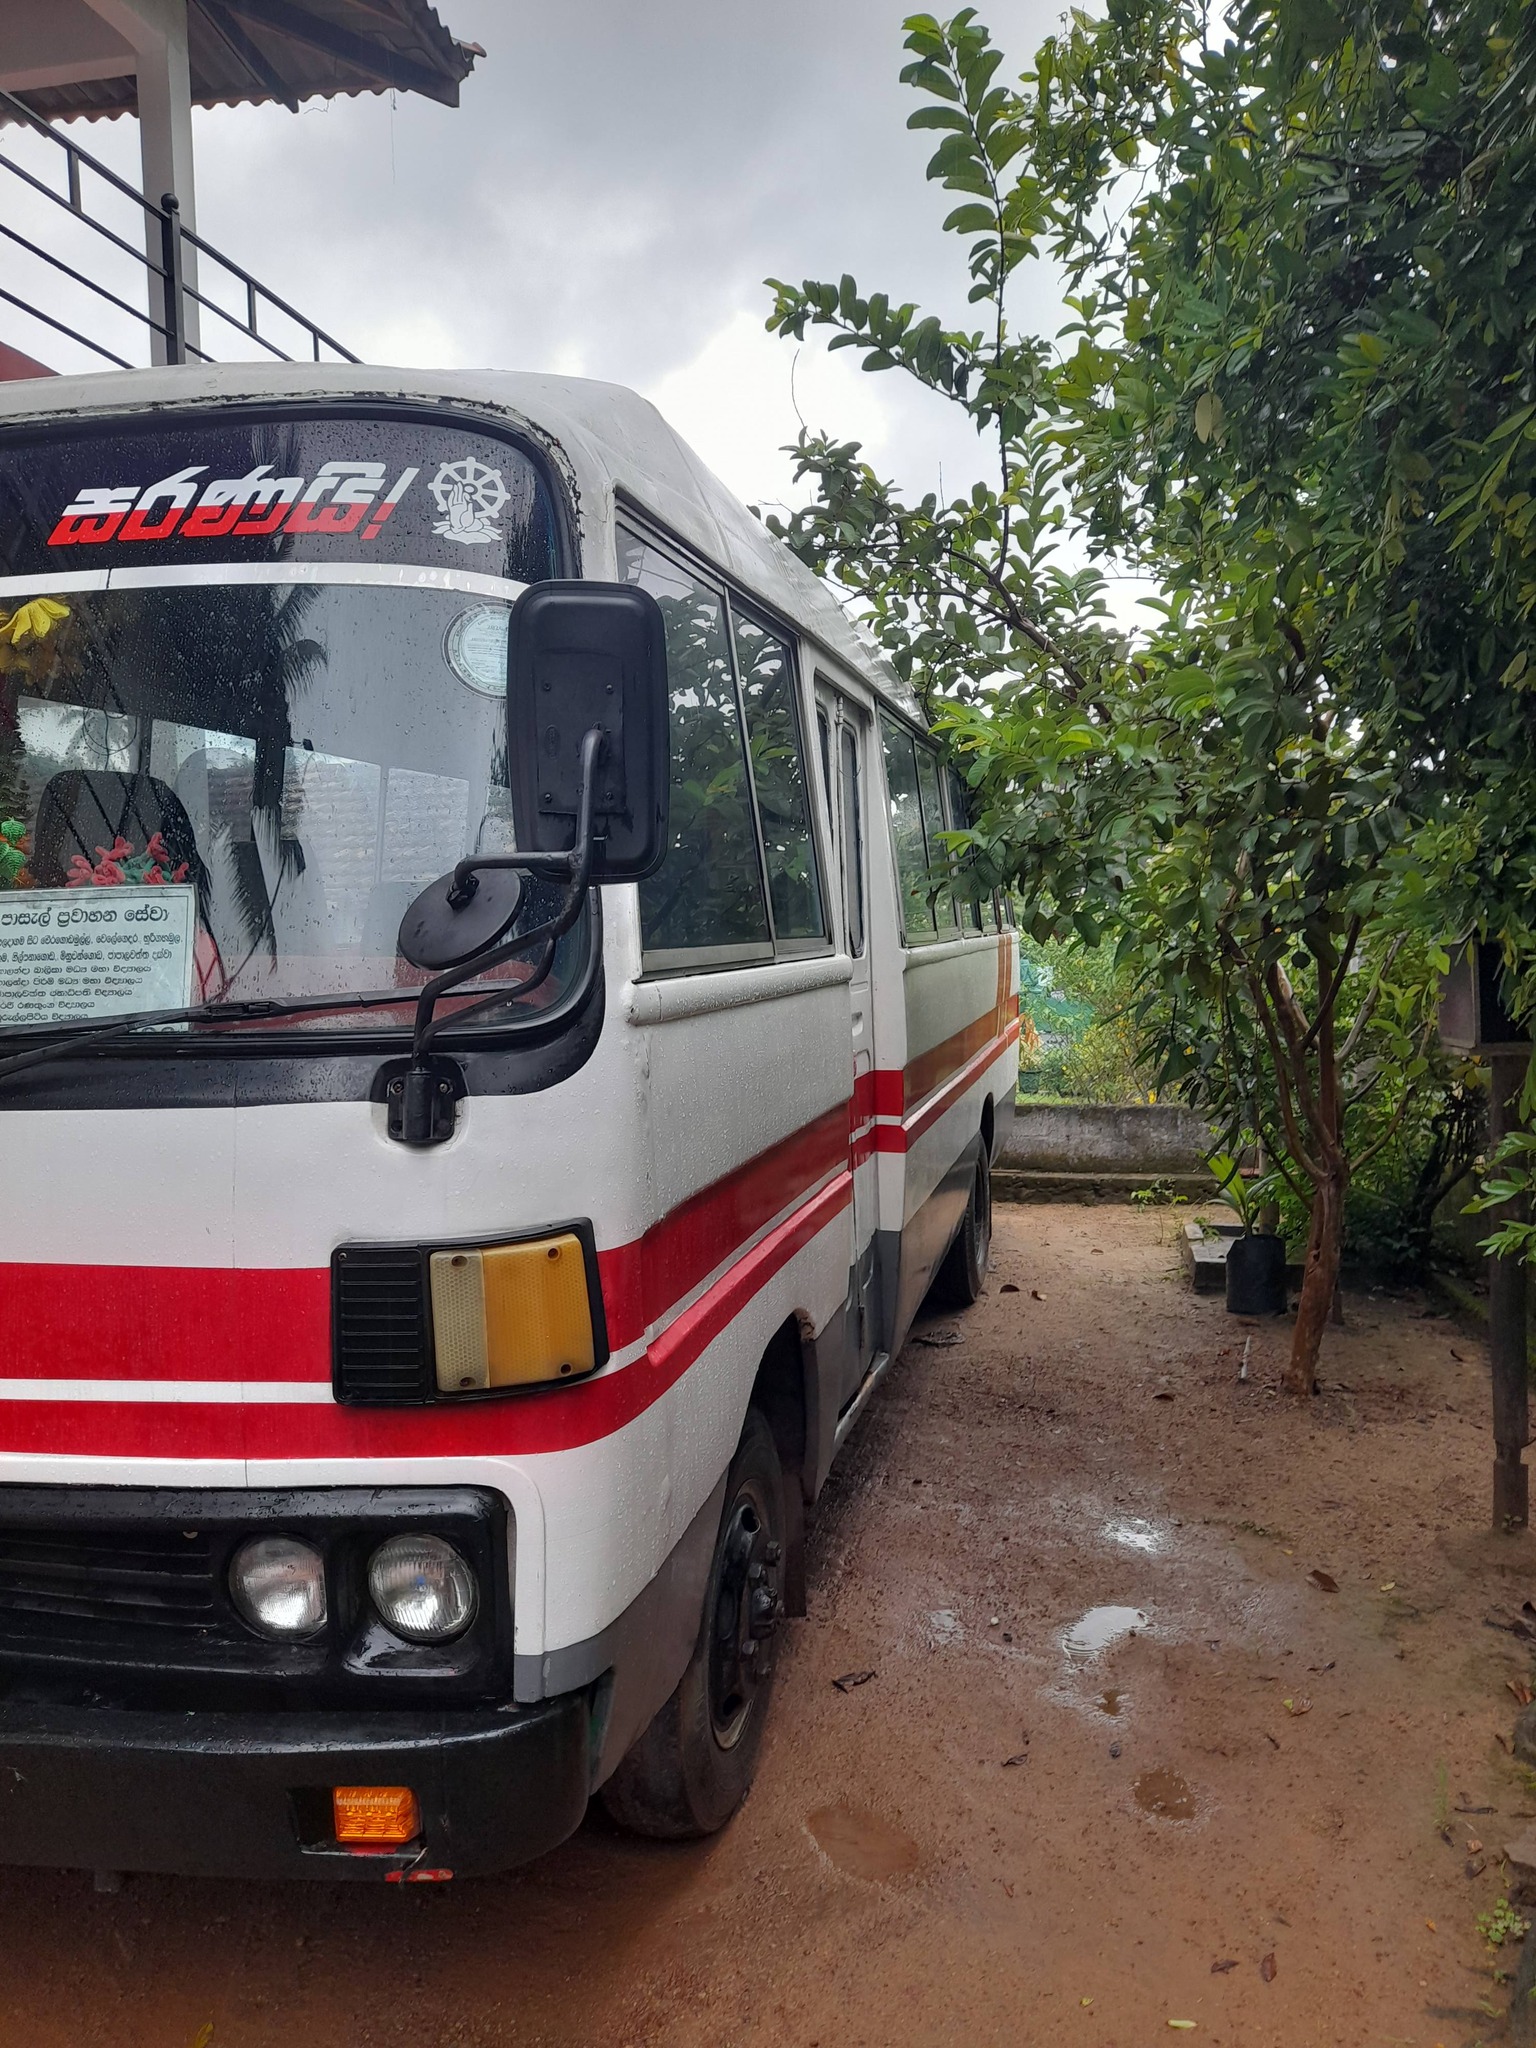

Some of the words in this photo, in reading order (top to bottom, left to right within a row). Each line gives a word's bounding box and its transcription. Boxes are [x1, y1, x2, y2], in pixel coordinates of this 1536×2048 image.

[46, 461, 420, 546] සරණයි!
[1, 907, 52, 927] පාසැල්
[57, 908, 117, 927] ප්‍රවාහන
[124, 904, 169, 921] සේවා
